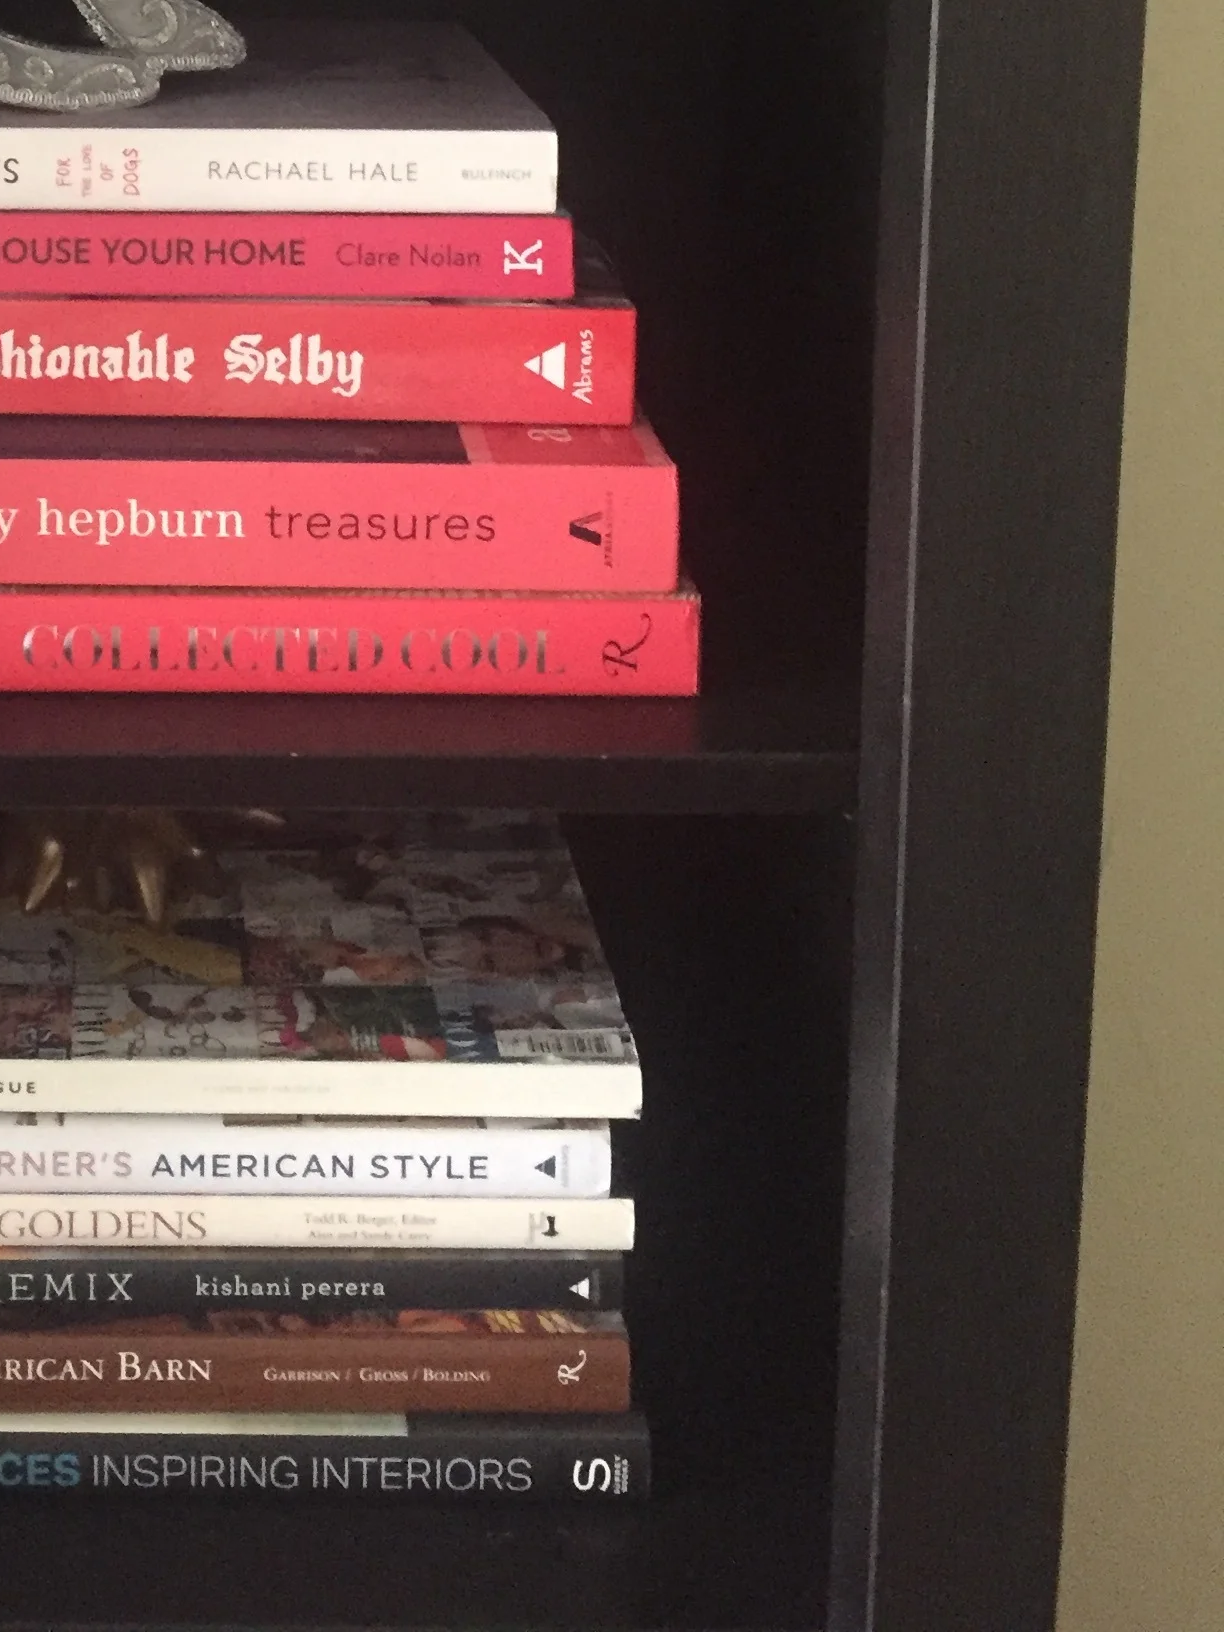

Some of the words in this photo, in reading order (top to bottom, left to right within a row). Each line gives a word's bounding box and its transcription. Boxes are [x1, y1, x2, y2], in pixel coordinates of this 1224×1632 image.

[81, 144, 93, 170] LOVE
[207, 160, 333, 182] RACHAEL
[349, 161, 419, 183] HALE
[55, 157, 73, 188] FOR
[81, 173, 93, 198] THE
[99, 162, 114, 183] OF
[122, 147, 141, 197] DOGS
[101, 238, 195, 266] YOUR
[205, 239, 306, 266] HOME
[335, 242, 401, 268] Clare
[410, 244, 481, 268] Nolan
[222, 333, 364, 398] Selby
[571, 328, 594, 405] Abrams
[37, 498, 246, 546] hepburn
[264, 503, 496, 545] treasures
[22, 624, 385, 673] COLLECTED
[400, 627, 566, 675] COOL
[151, 1153, 355, 1179] AMERICAN
[370, 1154, 489, 1179] STYLE
[194, 1274, 292, 1297] kishani
[301, 1279, 386, 1301] perera
[118, 1351, 212, 1381] BARN
[91, 1454, 299, 1490] INSPIRING
[311, 1457, 533, 1492] INTERIORS
